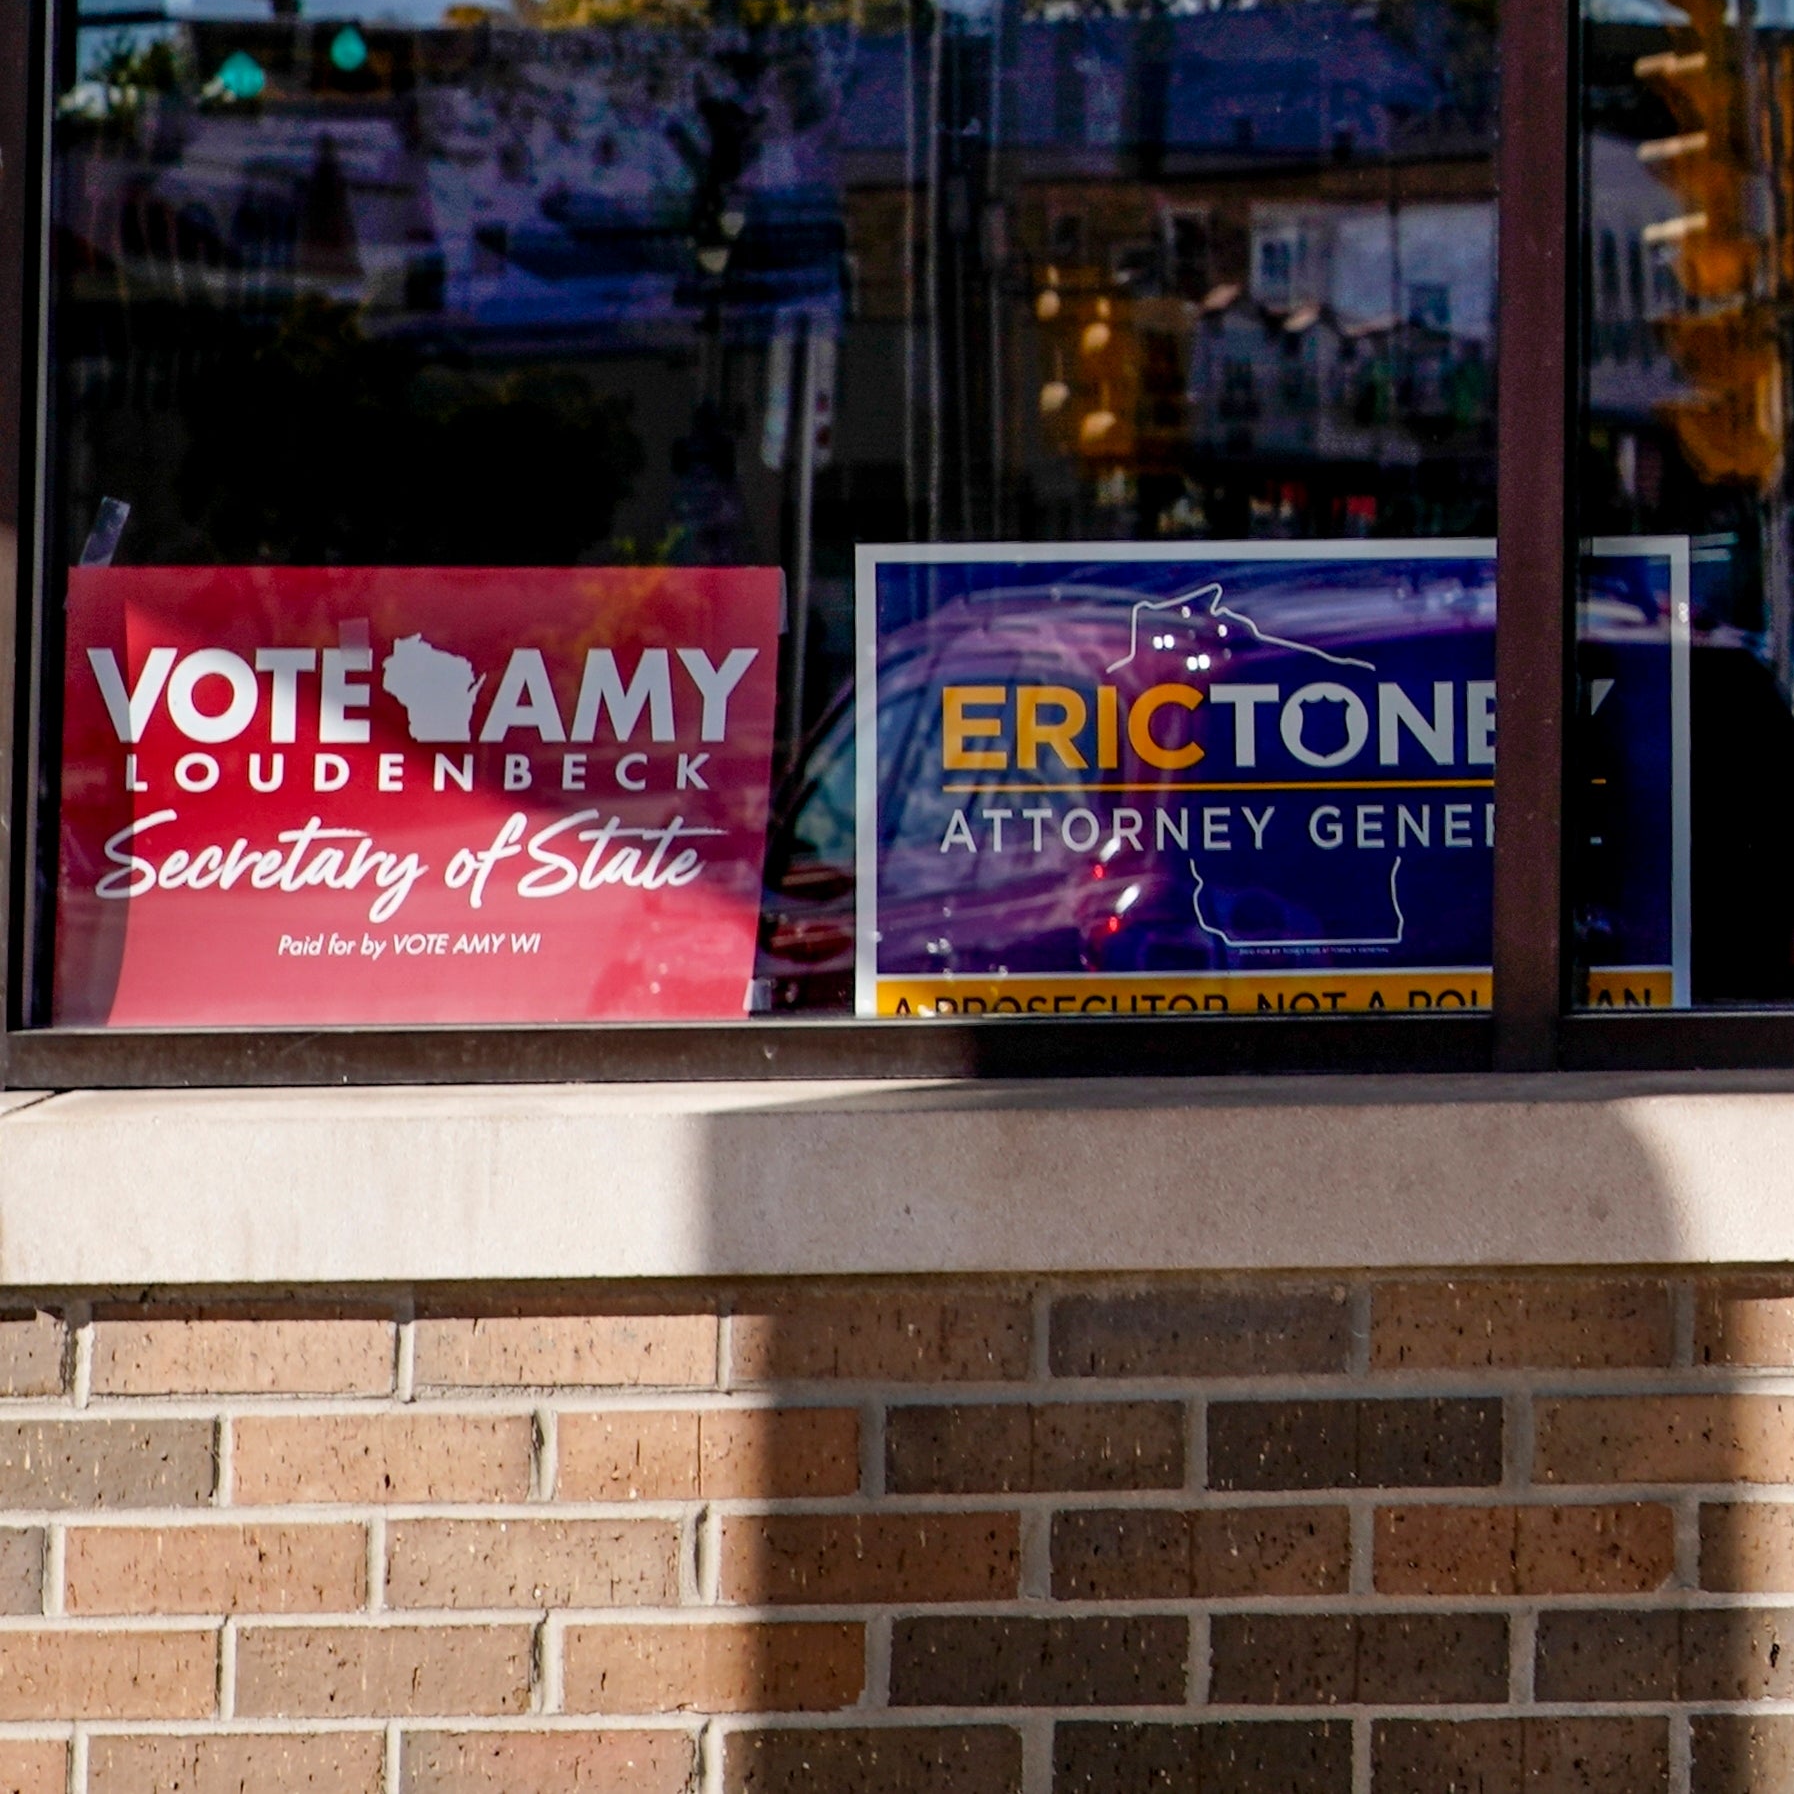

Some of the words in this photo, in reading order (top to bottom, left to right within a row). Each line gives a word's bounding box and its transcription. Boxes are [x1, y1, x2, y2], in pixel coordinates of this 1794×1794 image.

[86, 647, 373, 744] VOTE
[478, 647, 760, 744] AMY
[1209, 679, 1616, 770] TONE
[125, 752, 712, 794] LOUDENBECK
[940, 805, 1278, 855] ATTORNEY
[1309, 802, 1602, 852] GENE
[94, 809, 427, 924] Secretary
[442, 812, 527, 910] of
[517, 809, 729, 900] State
[277, 932, 325, 956] Paid
[328, 932, 357, 956] for
[360, 932, 388, 962] by
[392, 932, 450, 956] VOTE
[452, 932, 506, 955] AMY
[510, 932, 543, 955] WI
